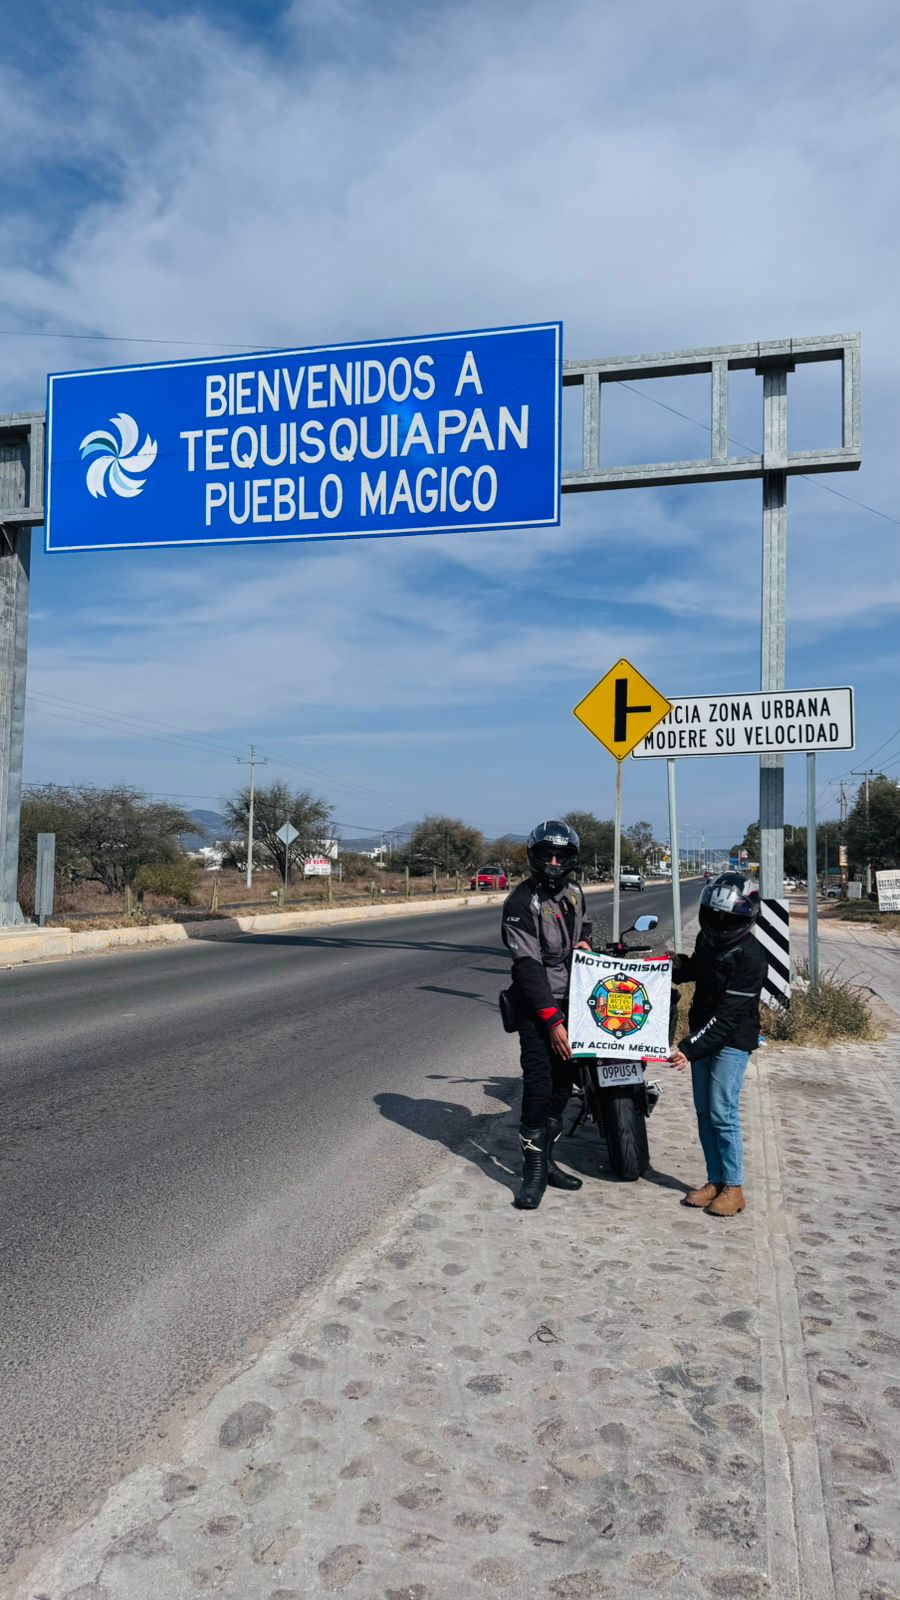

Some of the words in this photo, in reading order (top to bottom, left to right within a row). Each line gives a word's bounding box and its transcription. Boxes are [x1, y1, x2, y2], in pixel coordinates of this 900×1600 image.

[204, 354, 436, 417] BIENVENIDOS
[454, 350, 484, 398] A
[180, 404, 530, 472] TEQUISQUIAPAN
[204, 472, 343, 527] PUEBLO
[360, 464, 498, 517] MAGICO
[659, 705, 701, 725] ICIA
[709, 701, 752, 722] ZONA
[761, 697, 831, 719] URBANA
[644, 729, 707, 750] MODERE
[715, 727, 736, 747] SU
[744, 723, 839, 745] VELOCIDAD
[571, 1041, 585, 1049] EN
[588, 1041, 625, 1050] ACCIÓN
[629, 1043, 666, 1053] MÉXICO
[602, 1064, 637, 1079] 09PUS4
